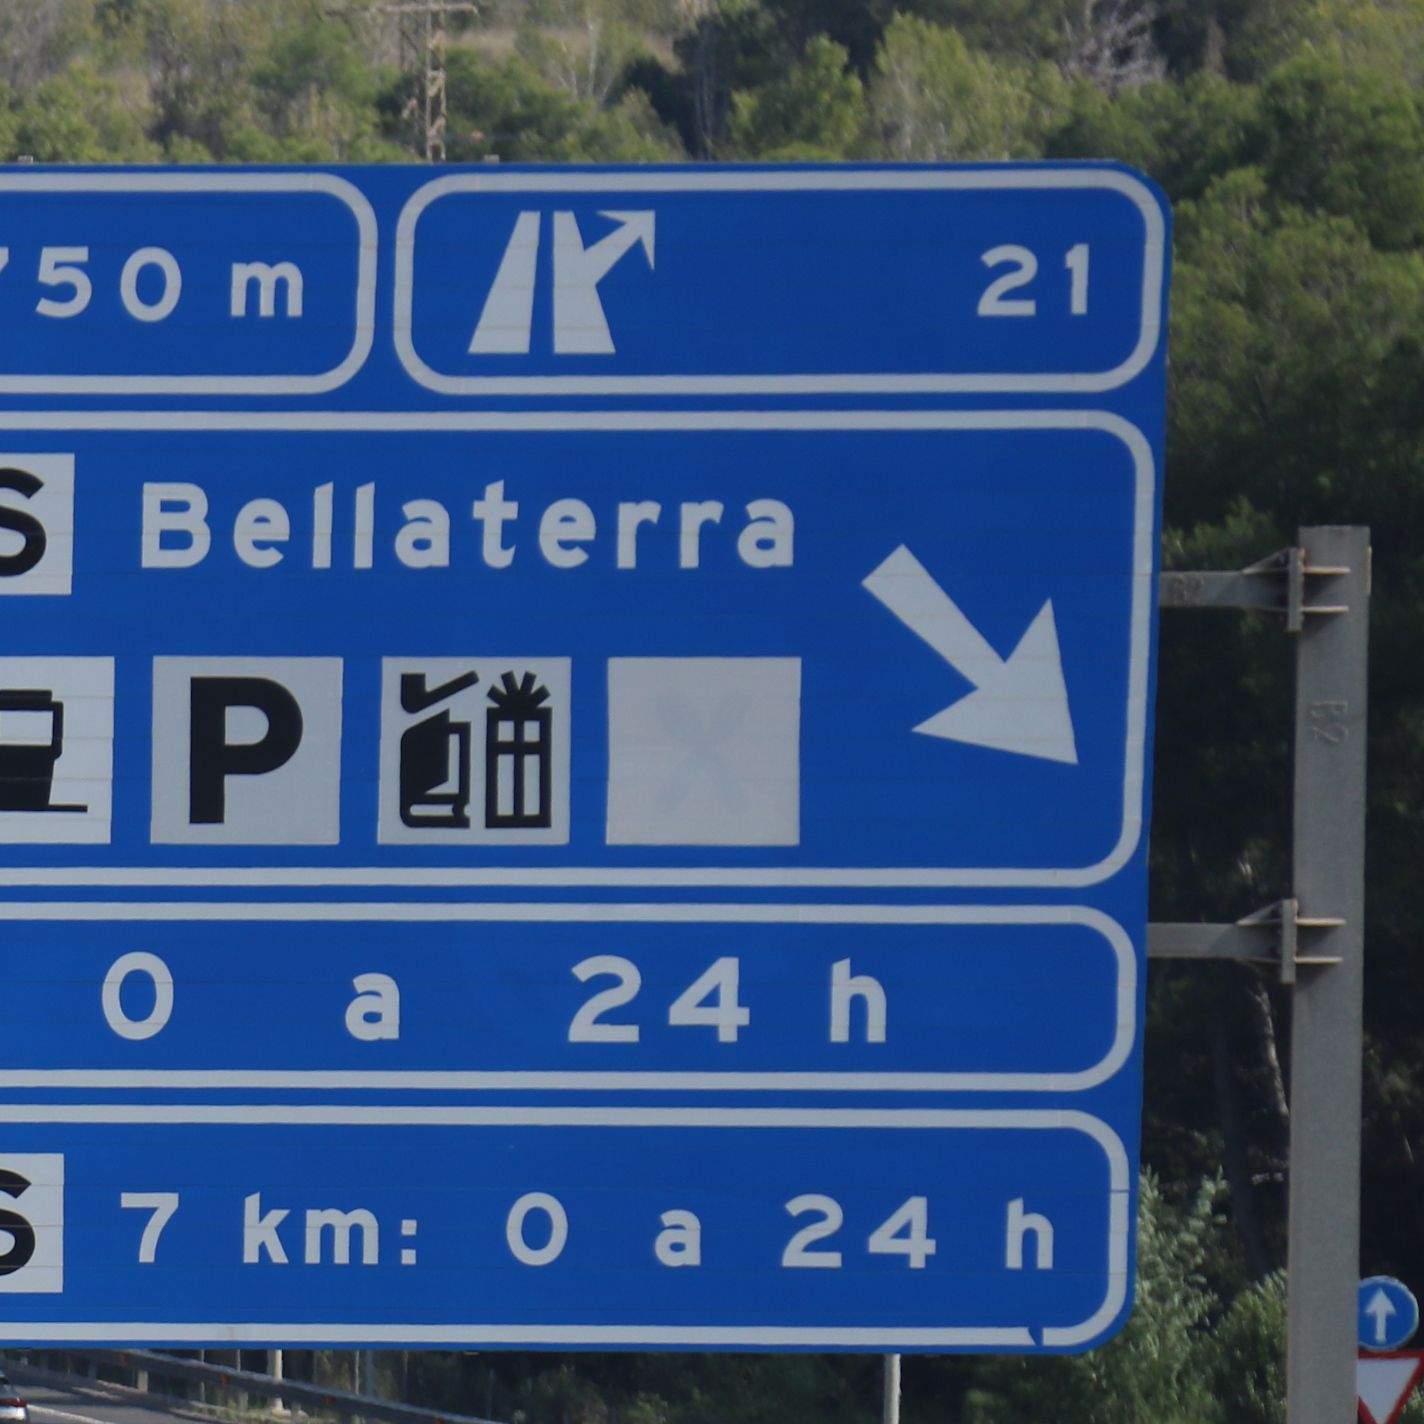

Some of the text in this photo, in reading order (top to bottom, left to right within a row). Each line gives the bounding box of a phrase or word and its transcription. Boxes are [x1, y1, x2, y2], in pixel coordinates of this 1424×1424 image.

[231, 260, 303, 317] m
[978, 243, 1089, 317] 21
[141, 479, 795, 570] Bellaterra
[189, 677, 303, 824] P
[101, 951, 888, 1043] 0 a 24 h
[120, 1192, 180, 1264] 7
[243, 1192, 417, 1266] km:
[506, 1192, 568, 1266] 0
[655, 1209, 702, 1266] a
[782, 1194, 937, 1270] 24
[1005, 1198, 1054, 1270] h
